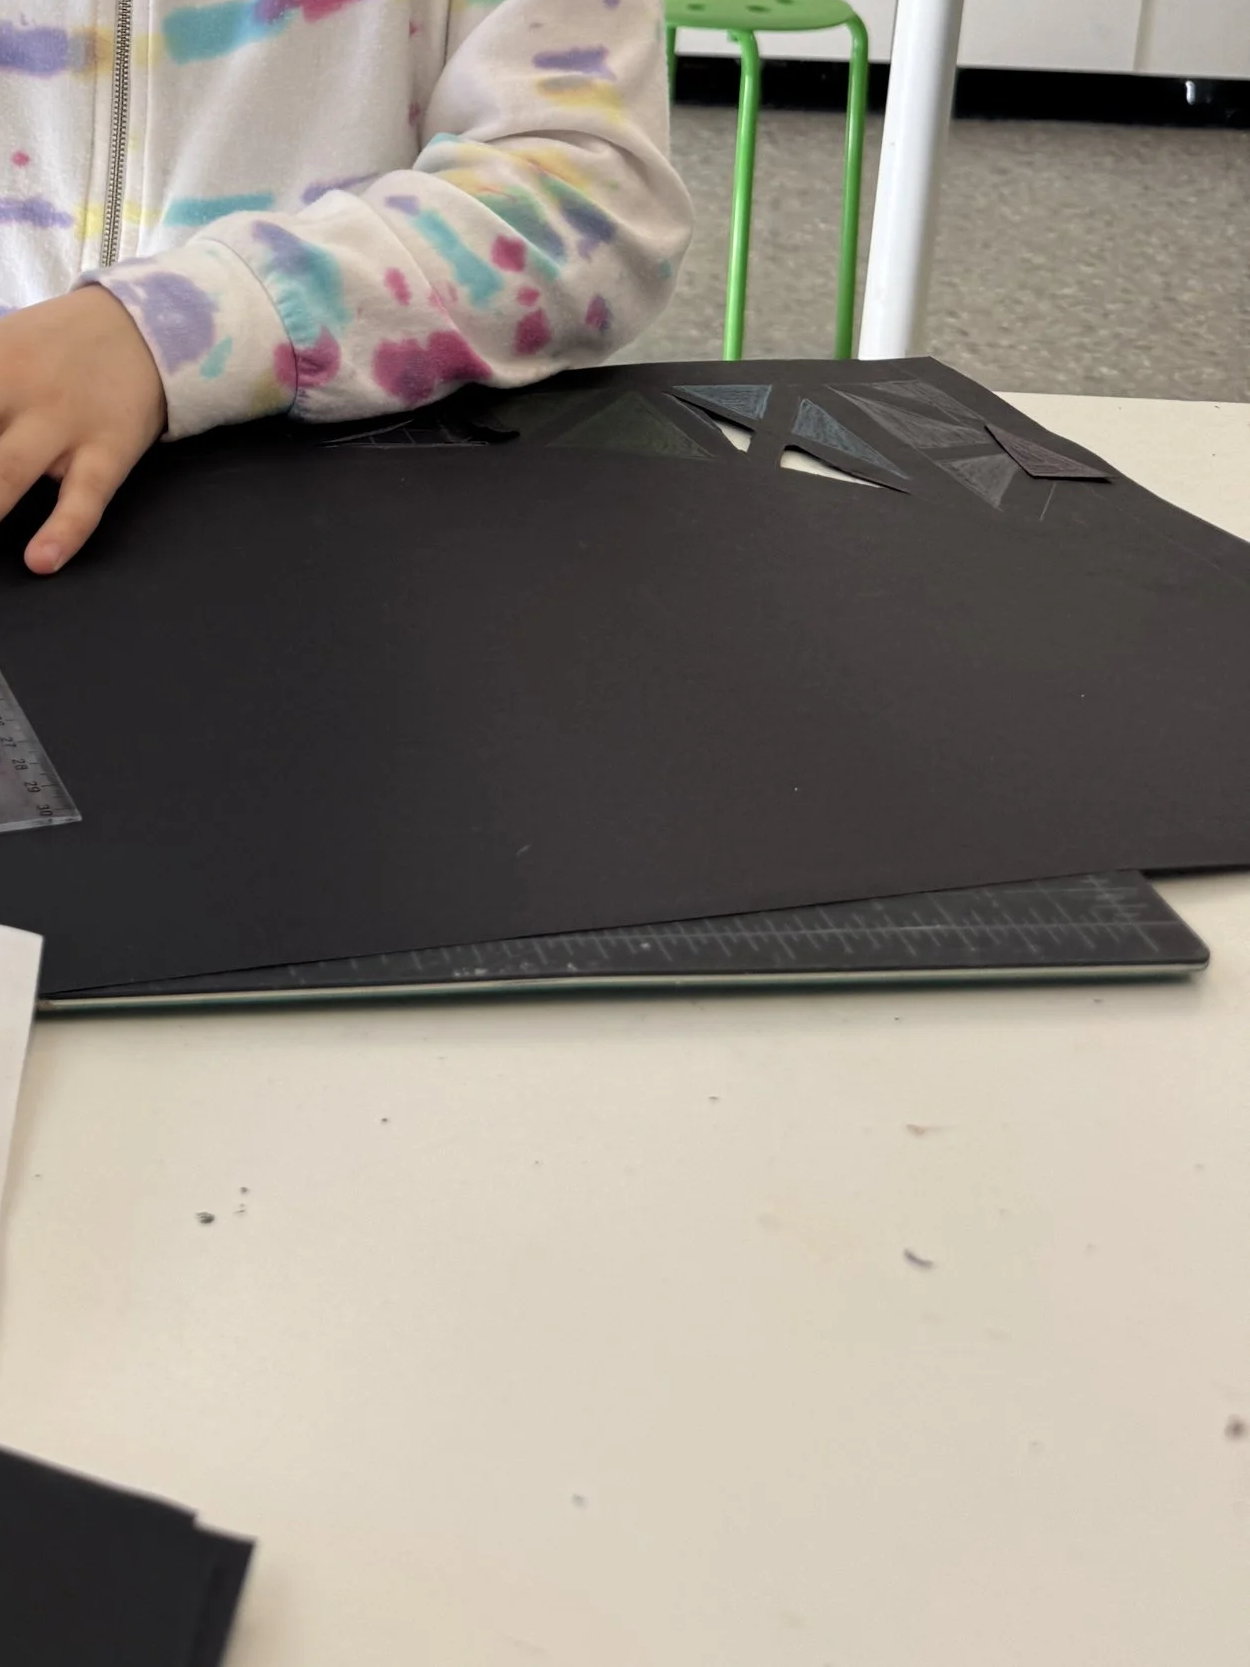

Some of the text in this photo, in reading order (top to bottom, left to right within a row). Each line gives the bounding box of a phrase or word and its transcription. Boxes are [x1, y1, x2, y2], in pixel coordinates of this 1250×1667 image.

[0, 736, 17, 748] 27
[12, 758, 29, 771] 28
[24, 781, 41, 793] 29
[36, 803, 53, 816] 30
